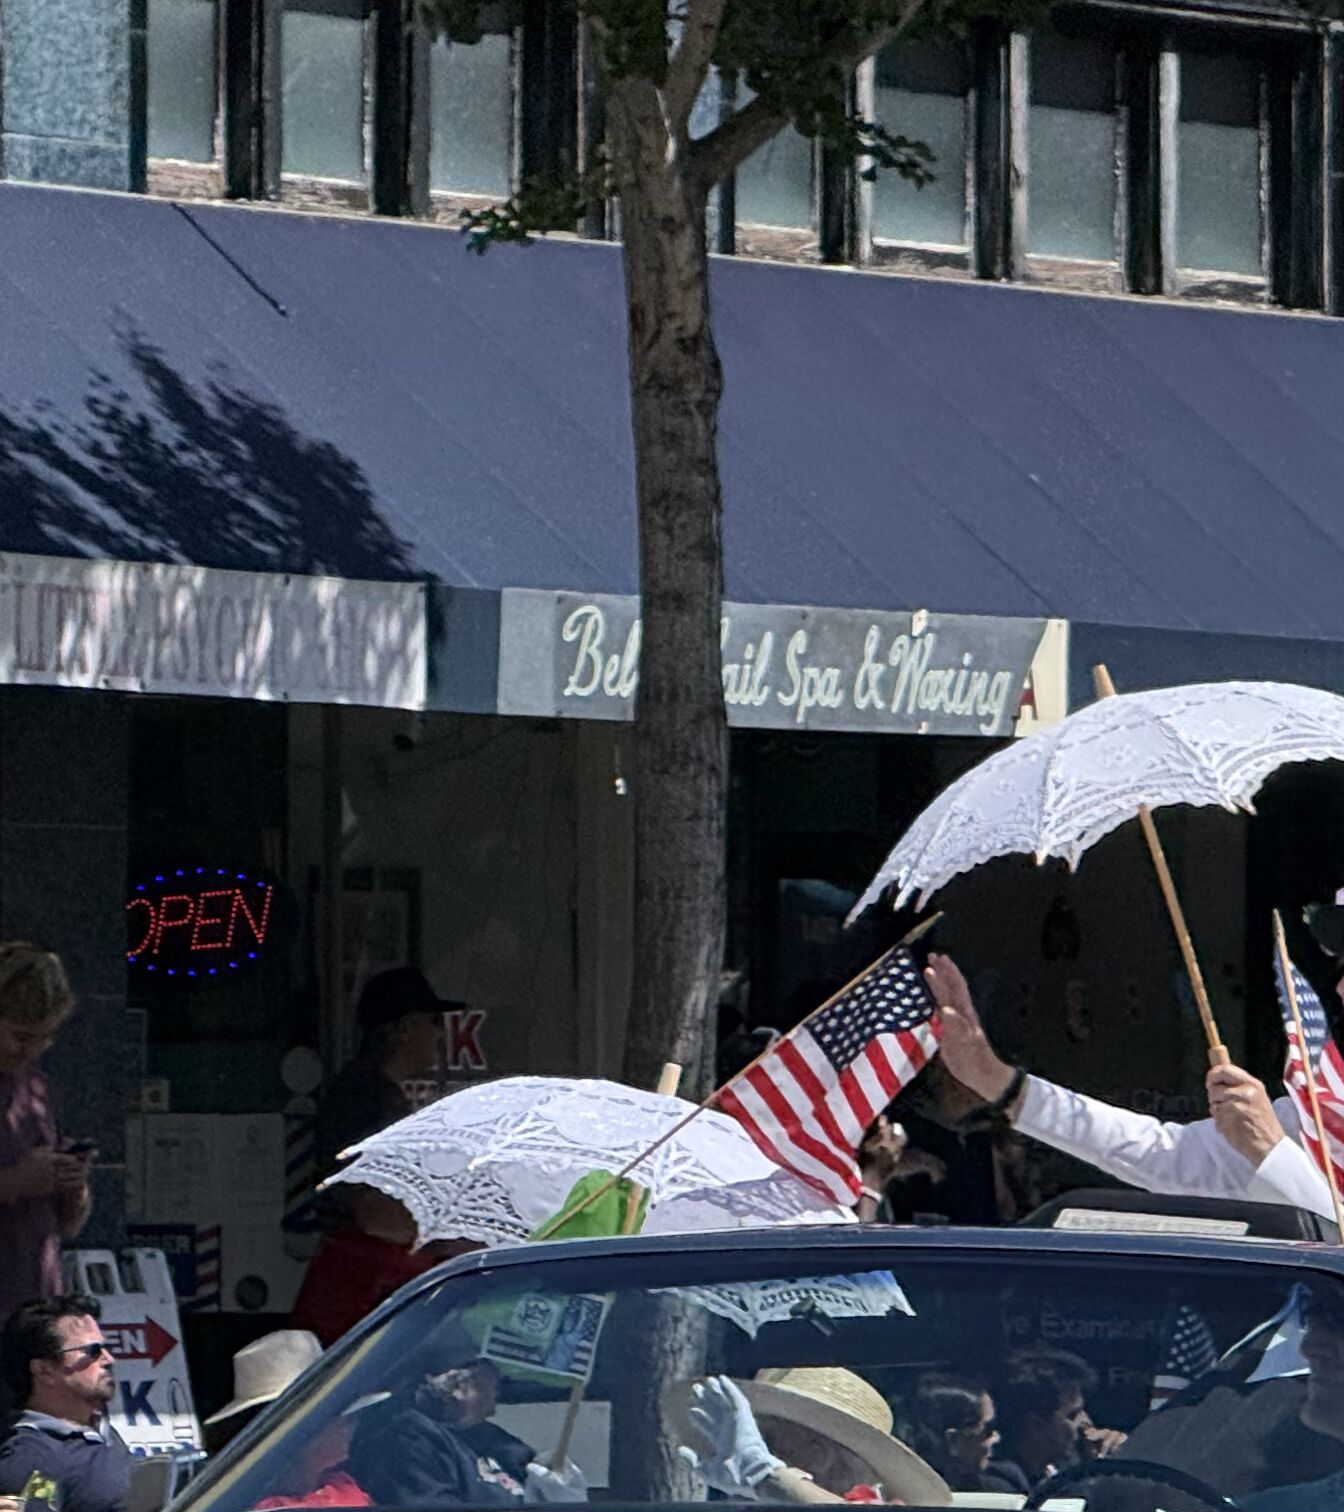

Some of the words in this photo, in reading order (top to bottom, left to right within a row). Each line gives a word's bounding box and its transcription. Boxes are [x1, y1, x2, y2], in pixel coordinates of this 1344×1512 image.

[777, 629, 845, 724] Spa
[854, 624, 886, 710] &
[888, 632, 1013, 737] Waxing
[124, 885, 273, 957] OPEN
[105, 1329, 147, 1354] EN
